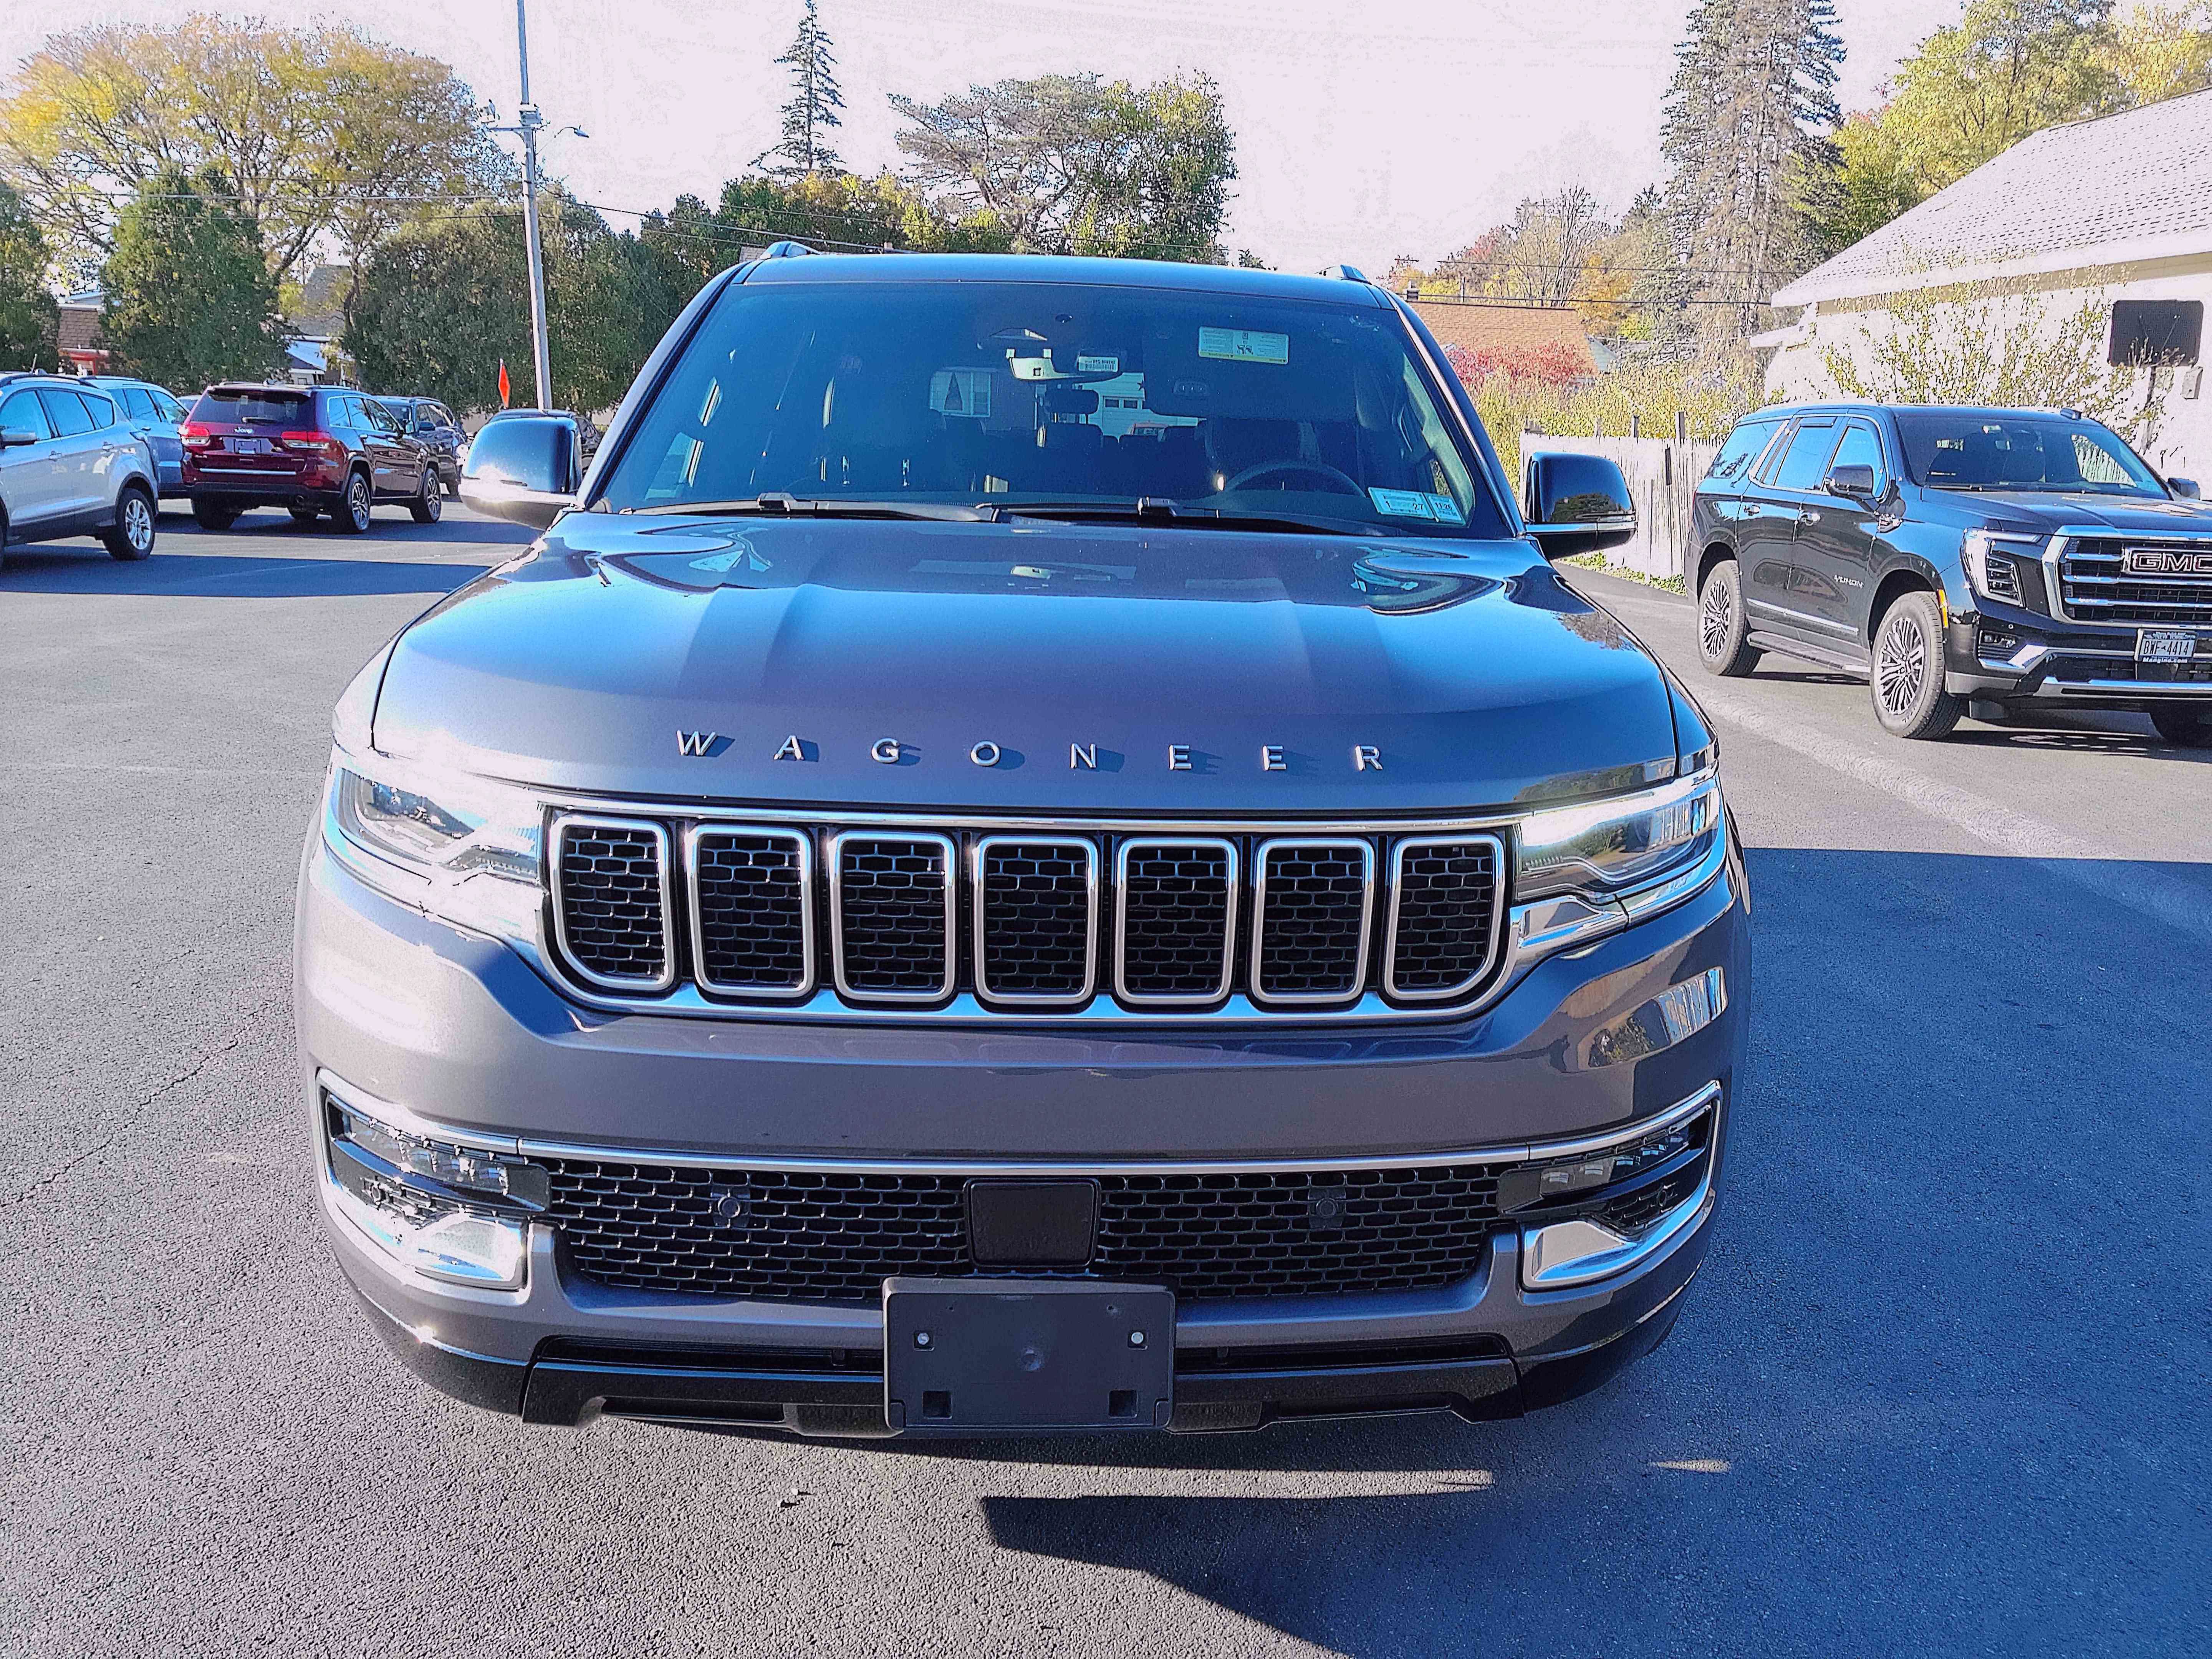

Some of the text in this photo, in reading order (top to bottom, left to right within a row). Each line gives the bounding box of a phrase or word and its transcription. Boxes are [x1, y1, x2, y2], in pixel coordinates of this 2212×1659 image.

[2132, 553, 2212, 571] GMC
[1834, 575, 1863, 589] YUKON
[2167, 641, 2189, 655] 4414
[677, 730, 1382, 770] WAGONEER
